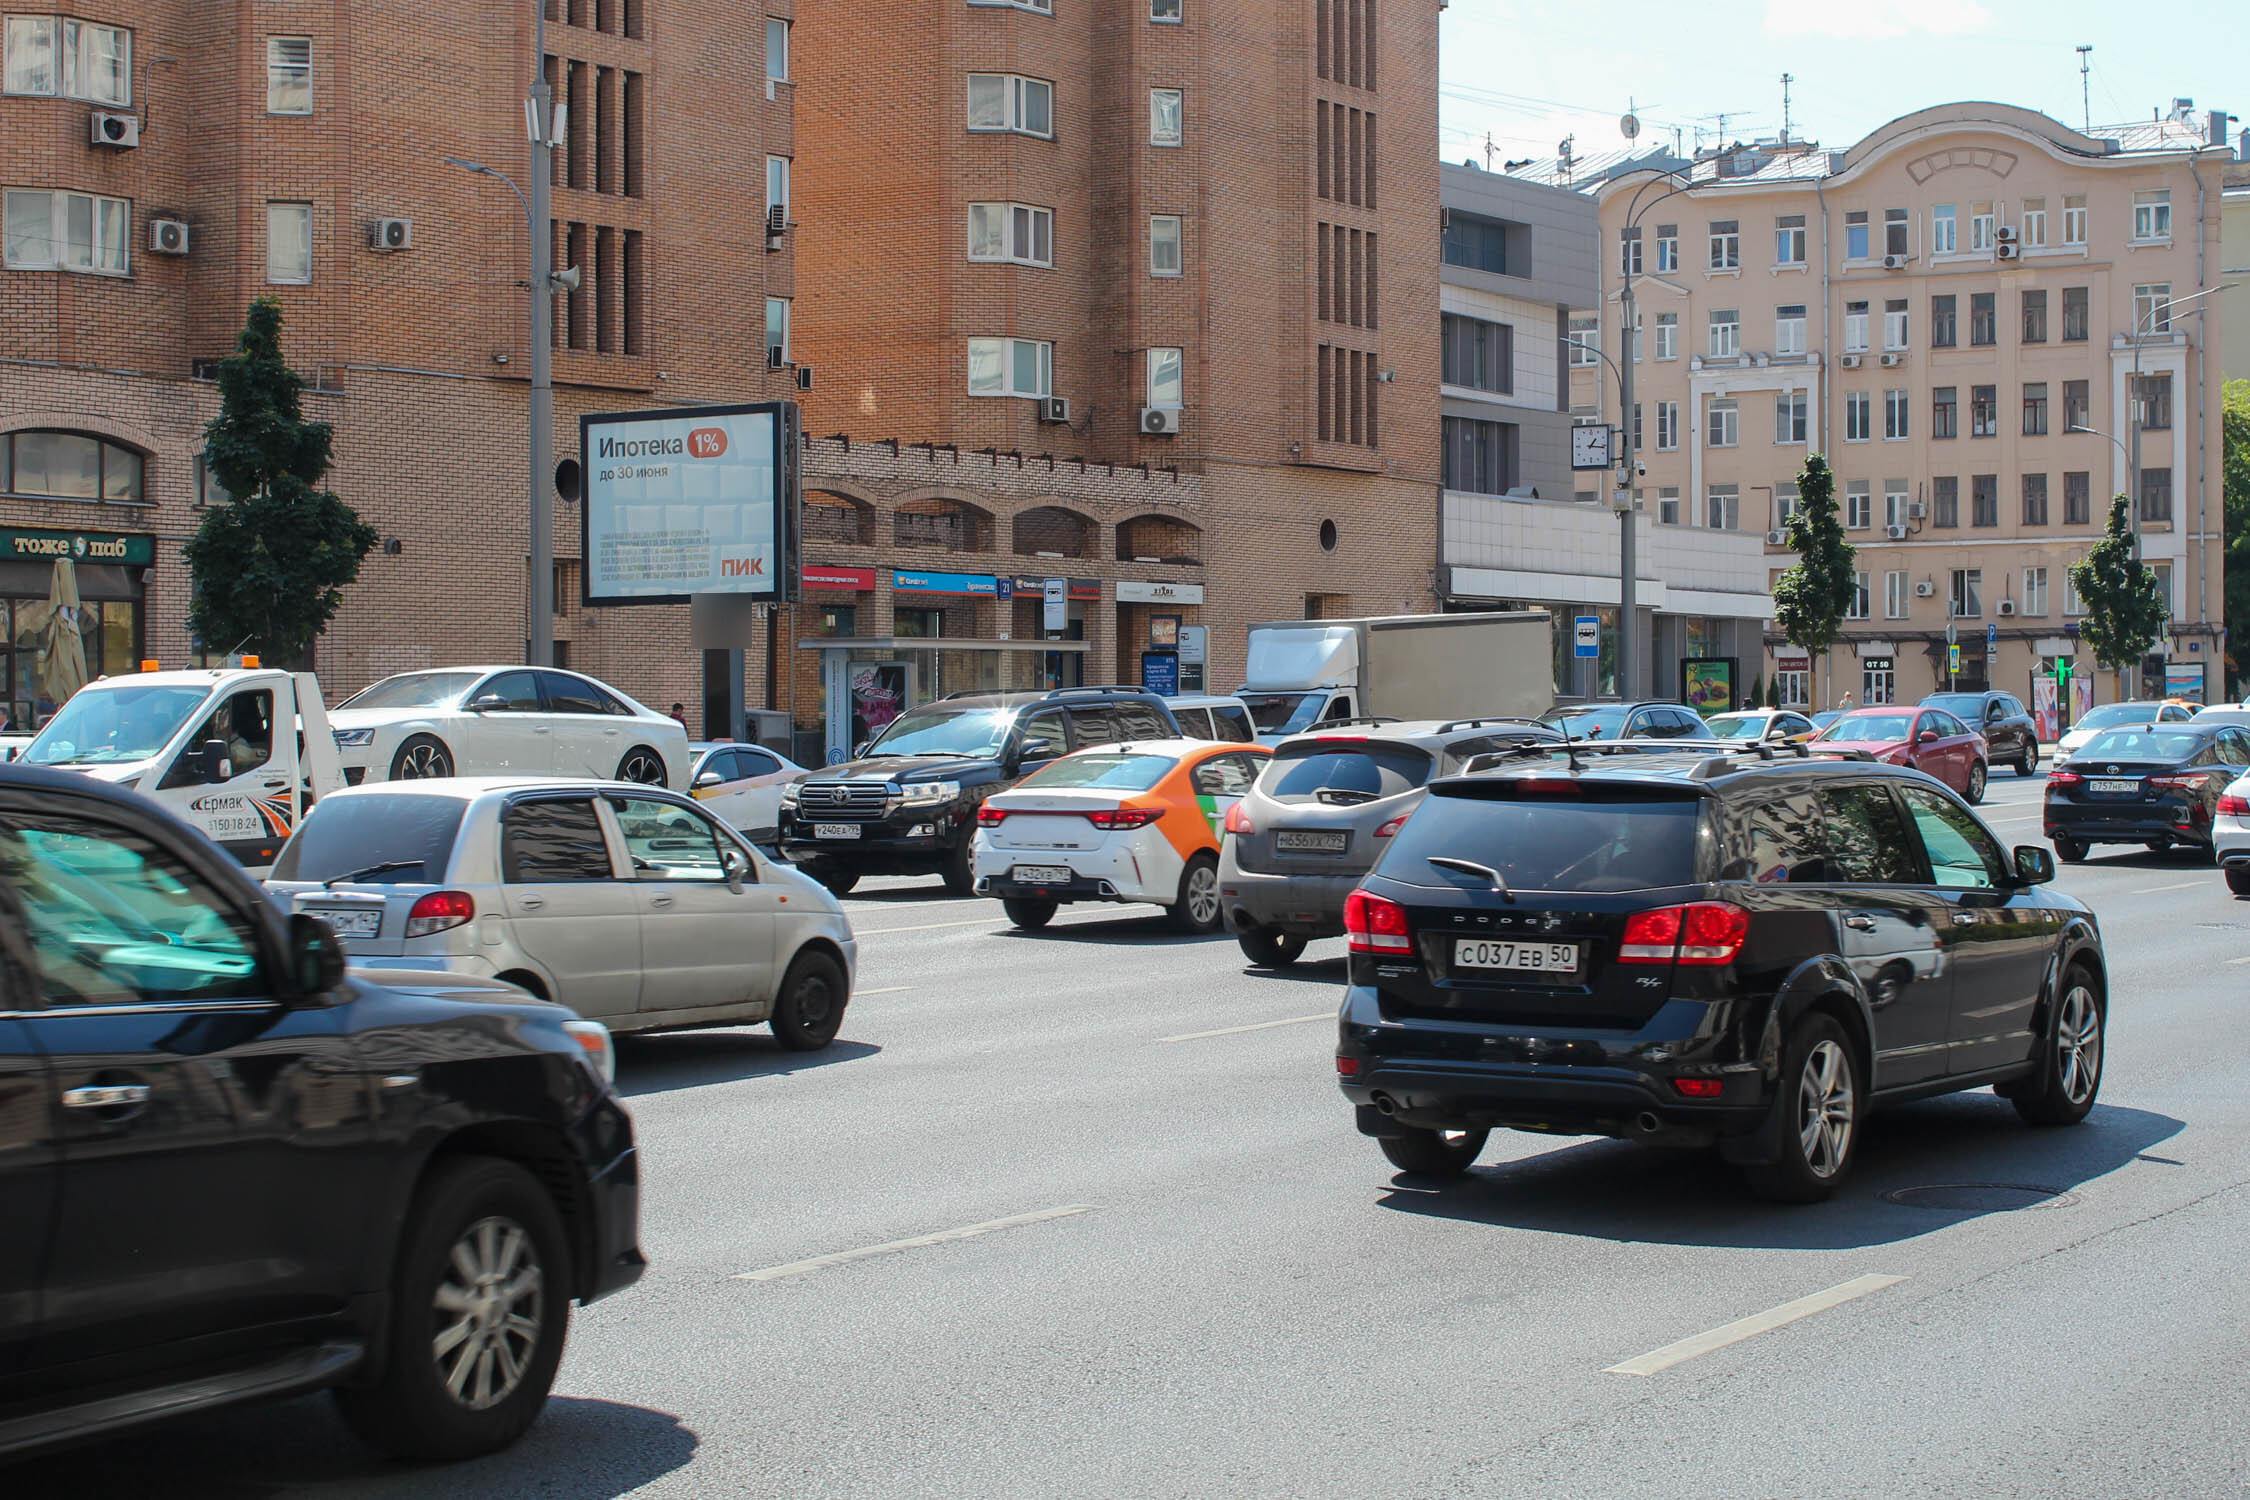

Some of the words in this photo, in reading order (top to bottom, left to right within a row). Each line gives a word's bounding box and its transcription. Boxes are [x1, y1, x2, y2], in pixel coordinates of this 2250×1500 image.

[599, 437, 683, 458] Ипотека
[695, 433, 719, 453] 1%
[599, 470, 615, 482] до
[617, 466, 634, 480] 30
[636, 466, 669, 479] июня
[14, 537, 70, 554] тоже
[89, 537, 127, 557] паб
[721, 557, 764, 577] ПИК
[1002, 583, 1010, 593] 21
[1879, 660, 1890, 669] 50
[1454, 915, 1561, 926] DODGE
[1551, 945, 1571, 963] 50
